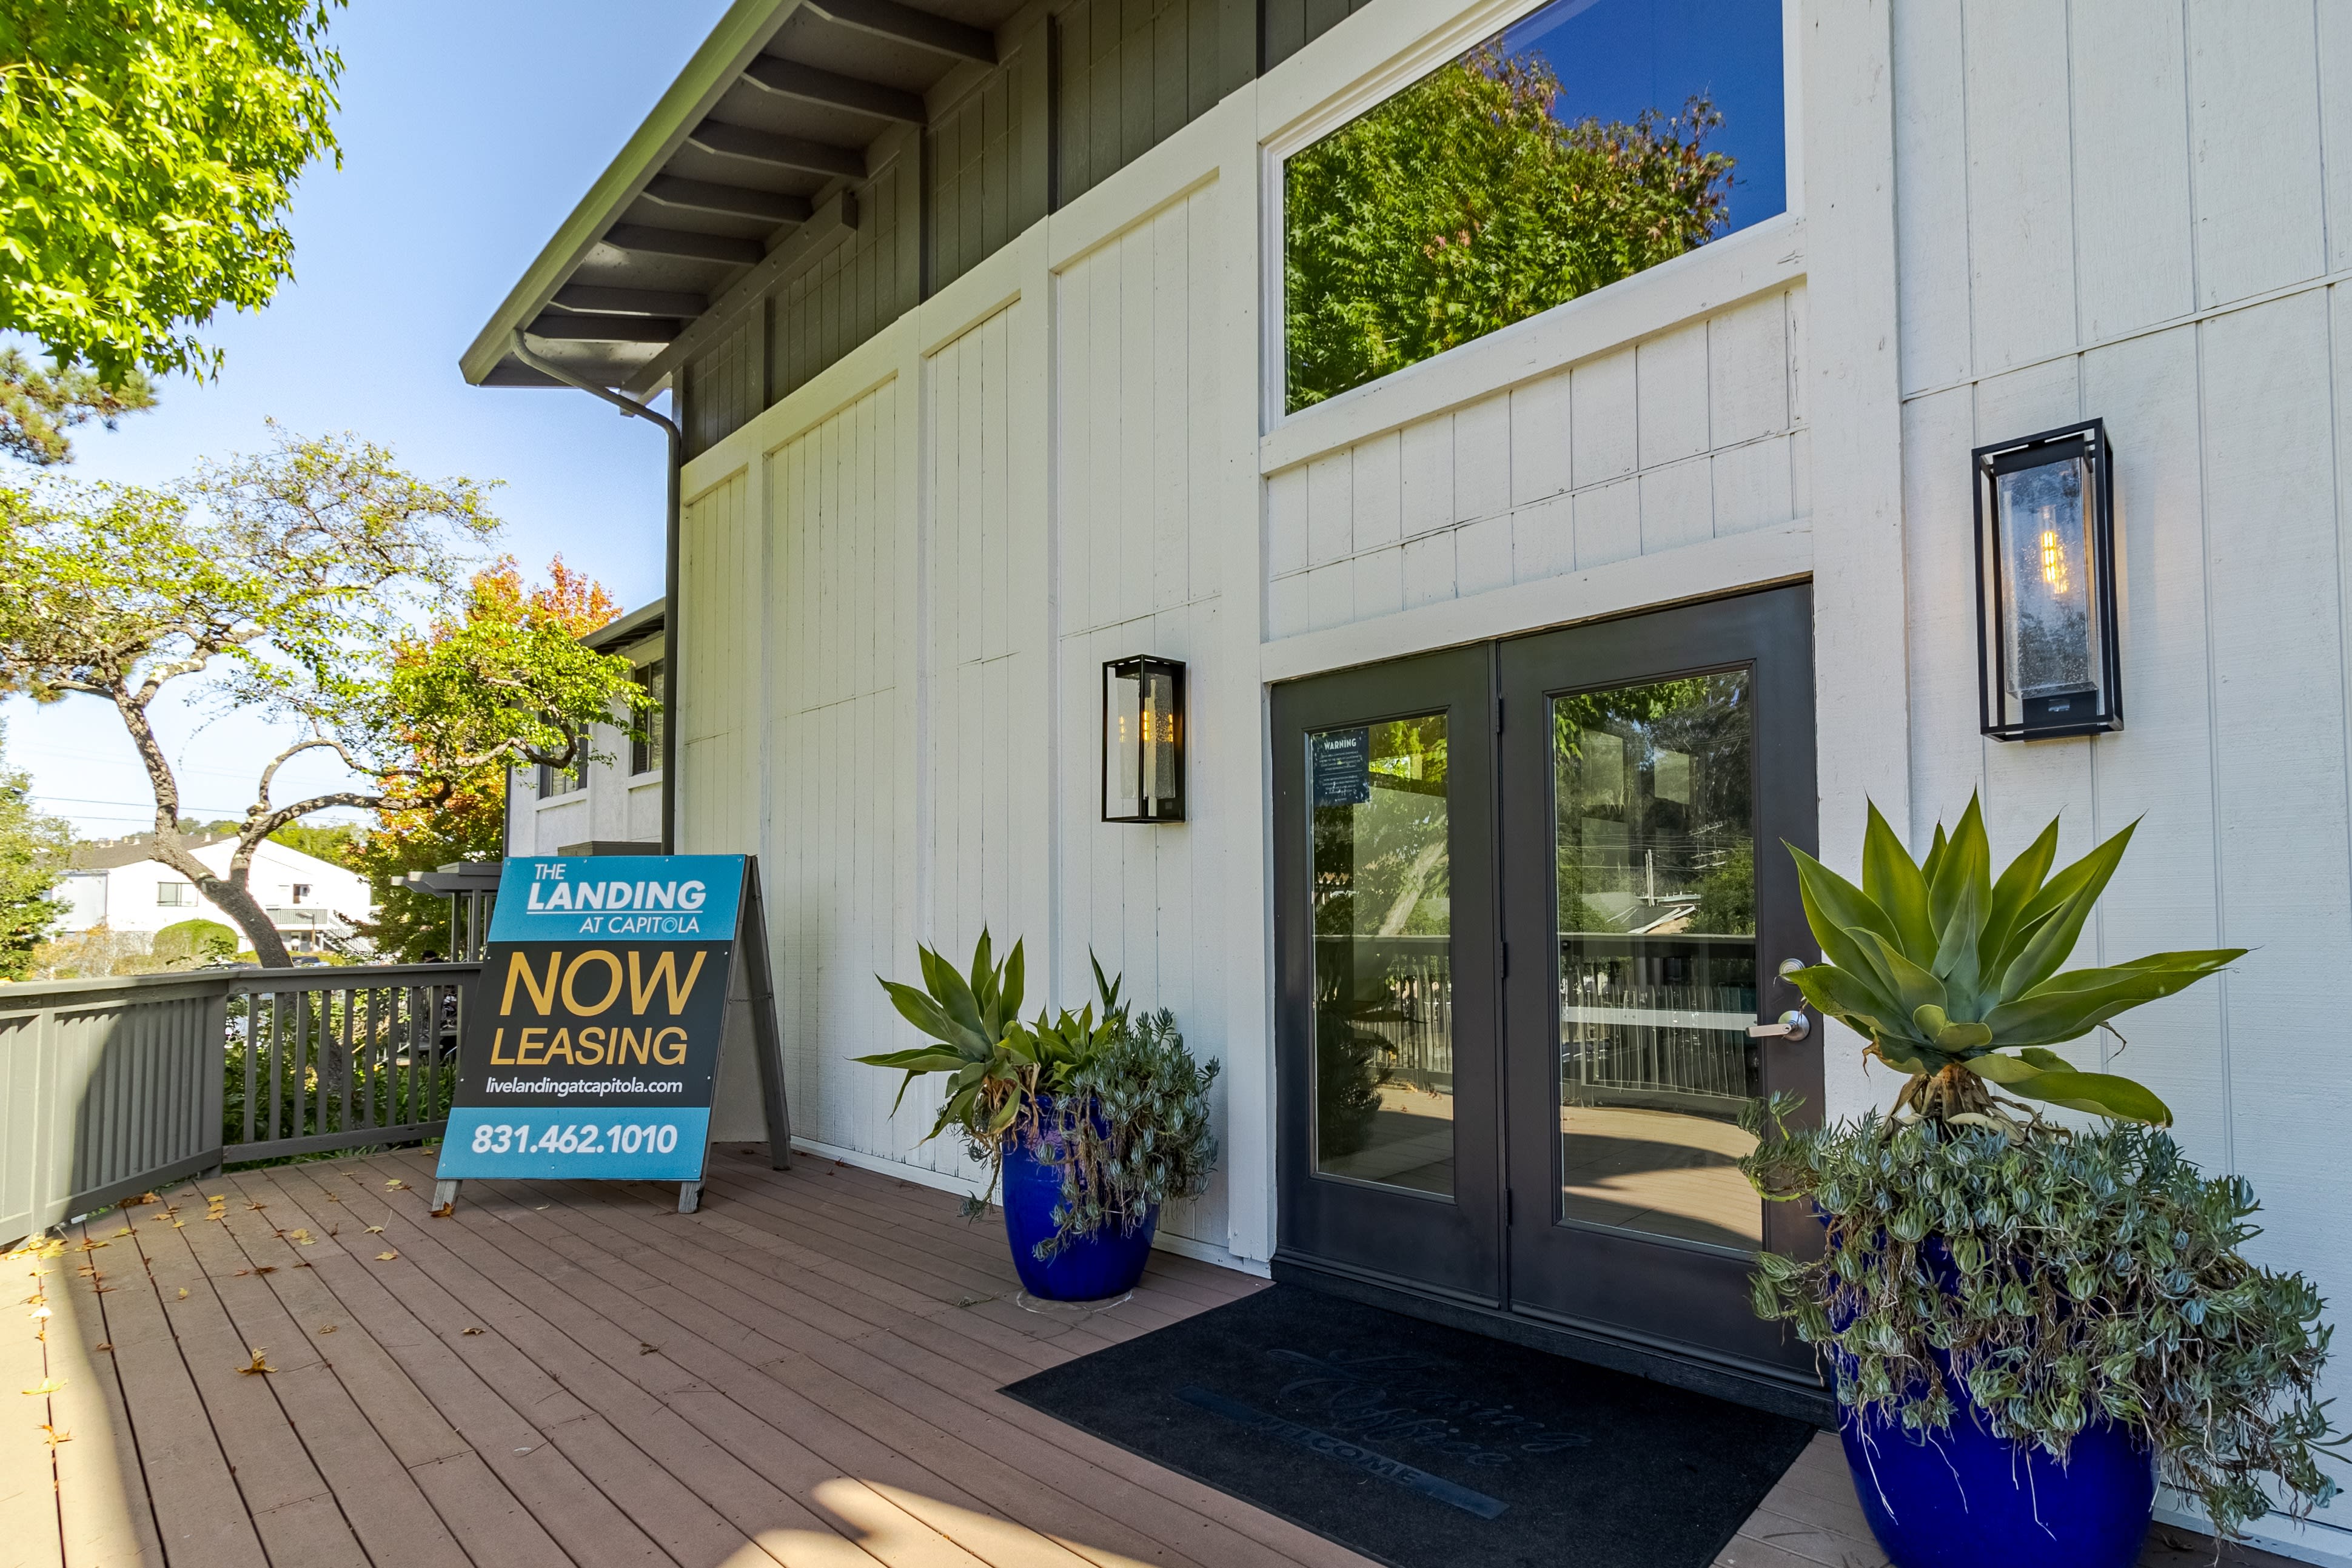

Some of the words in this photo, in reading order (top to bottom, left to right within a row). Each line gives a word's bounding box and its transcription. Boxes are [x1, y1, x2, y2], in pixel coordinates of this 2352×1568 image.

[1324, 738, 1356, 750] WARNING
[535, 863, 566, 879] THE
[527, 880, 706, 910] LANDING
[579, 916, 604, 933] AT
[608, 916, 700, 934] CAPITOLA
[500, 950, 707, 1017] NOW
[490, 1027, 687, 1065] LEASING
[486, 1077, 683, 1097] livelandingatcapitola.com
[472, 1125, 678, 1153] 831.462.1010
[1278, 1379, 1512, 1466] Office
[1251, 1413, 1424, 1484] WELCOME
